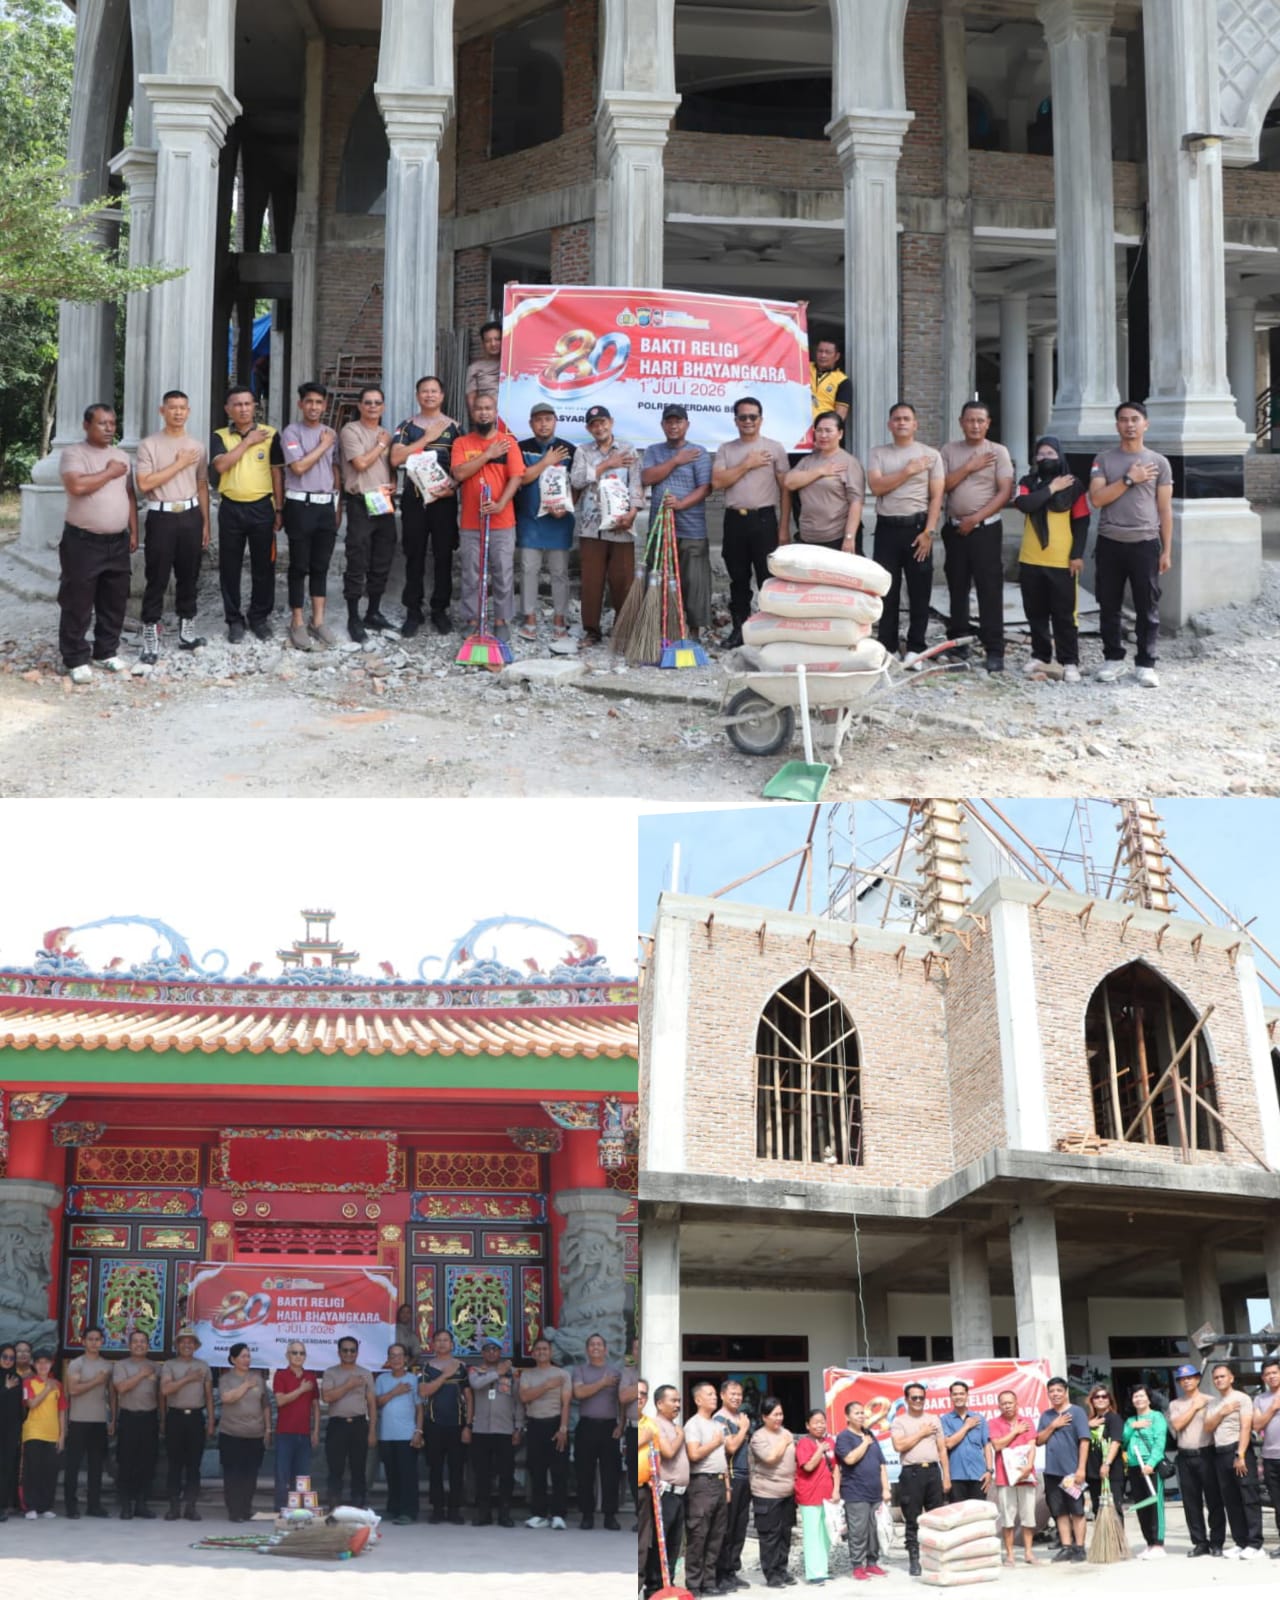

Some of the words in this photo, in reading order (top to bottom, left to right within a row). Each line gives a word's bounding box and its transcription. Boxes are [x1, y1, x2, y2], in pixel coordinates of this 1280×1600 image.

[639, 337, 686, 355] BAKTI
[691, 340, 739, 359] RELIGI
[639, 360, 678, 377] HARI
[682, 362, 787, 382] BHAYANGKARA
[652, 382, 687, 396] JULI
[690, 383, 726, 397] 2026
[277, 1296, 307, 1308] BAKTI
[310, 1297, 344, 1308] RELIGI
[277, 1310, 302, 1321] HARI
[305, 1311, 380, 1322] BHAYANGKARA
[285, 1325, 307, 1334] JULI
[310, 1325, 335, 1335] 2026
